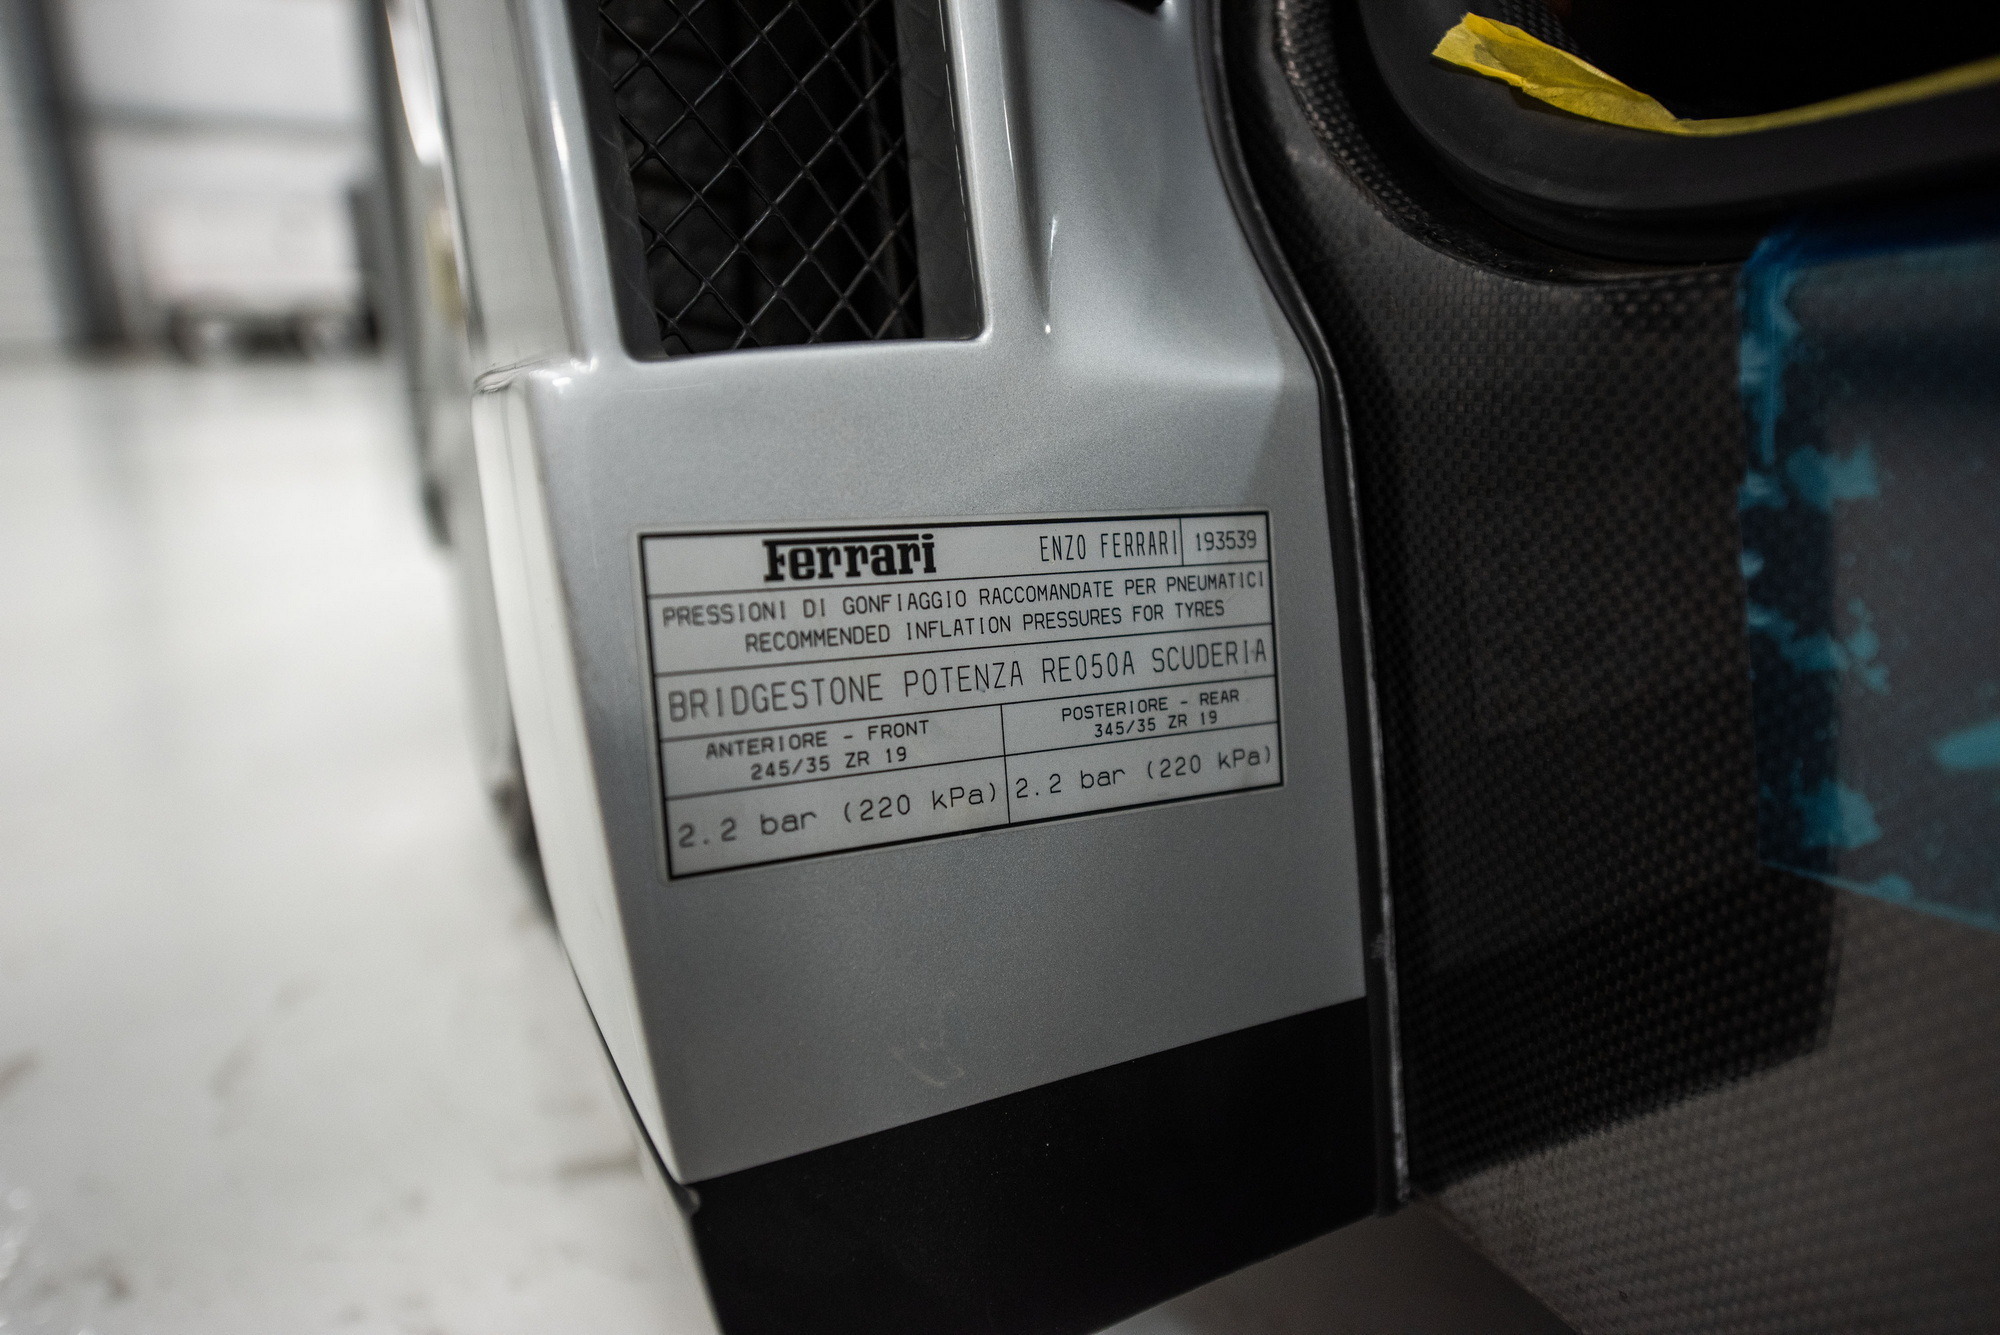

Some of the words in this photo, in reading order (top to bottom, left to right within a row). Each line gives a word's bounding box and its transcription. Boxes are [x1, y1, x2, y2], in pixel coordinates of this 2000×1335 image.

[762, 533, 937, 583] Ferrari
[1039, 534, 1086, 562] ENZO
[1100, 529, 1178, 558] FERRARI
[1196, 529, 1257, 551] 193539
[662, 600, 786, 627] PRESSIONI
[803, 598, 826, 619] DI
[842, 589, 966, 616] GONFIAGGIO
[979, 580, 1114, 605] RACCOMANDATE
[1125, 578, 1156, 596] PER
[1167, 571, 1264, 593] PNEUMATICI
[745, 624, 890, 653] RECOMMENDED
[907, 616, 1011, 641] INFLATION
[1023, 607, 1122, 630] PRESSURES
[1133, 605, 1164, 622] FOR
[1175, 600, 1224, 619] TYRES
[668, 673, 882, 722] BRIDGESTONE
[904, 661, 1023, 697] POTENZA
[1152, 638, 1267, 673] SCUDERIA
[1062, 697, 1168, 722] POSTERIORE
[1200, 689, 1239, 706] REAR
[1094, 718, 1156, 738] 345/35
[1168, 714, 1187, 728] ZR
[1200, 711, 1217, 725] 19
[705, 730, 827, 760] ANTERIORE
[868, 719, 929, 741] FRONT
[750, 754, 830, 781] 245/35
[845, 751, 869, 769] ZR
[886, 746, 907, 763] 19
[1016, 773, 1062, 799] 2.2
[1080, 767, 1125, 789] bar
[1148, 754, 1201, 780] (220
[1218, 745, 1271, 770] kPa)
[678, 818, 736, 849] 2.2
[760, 811, 817, 836] bar
[844, 793, 911, 824] (220
[932, 782, 996, 810] kPa)
